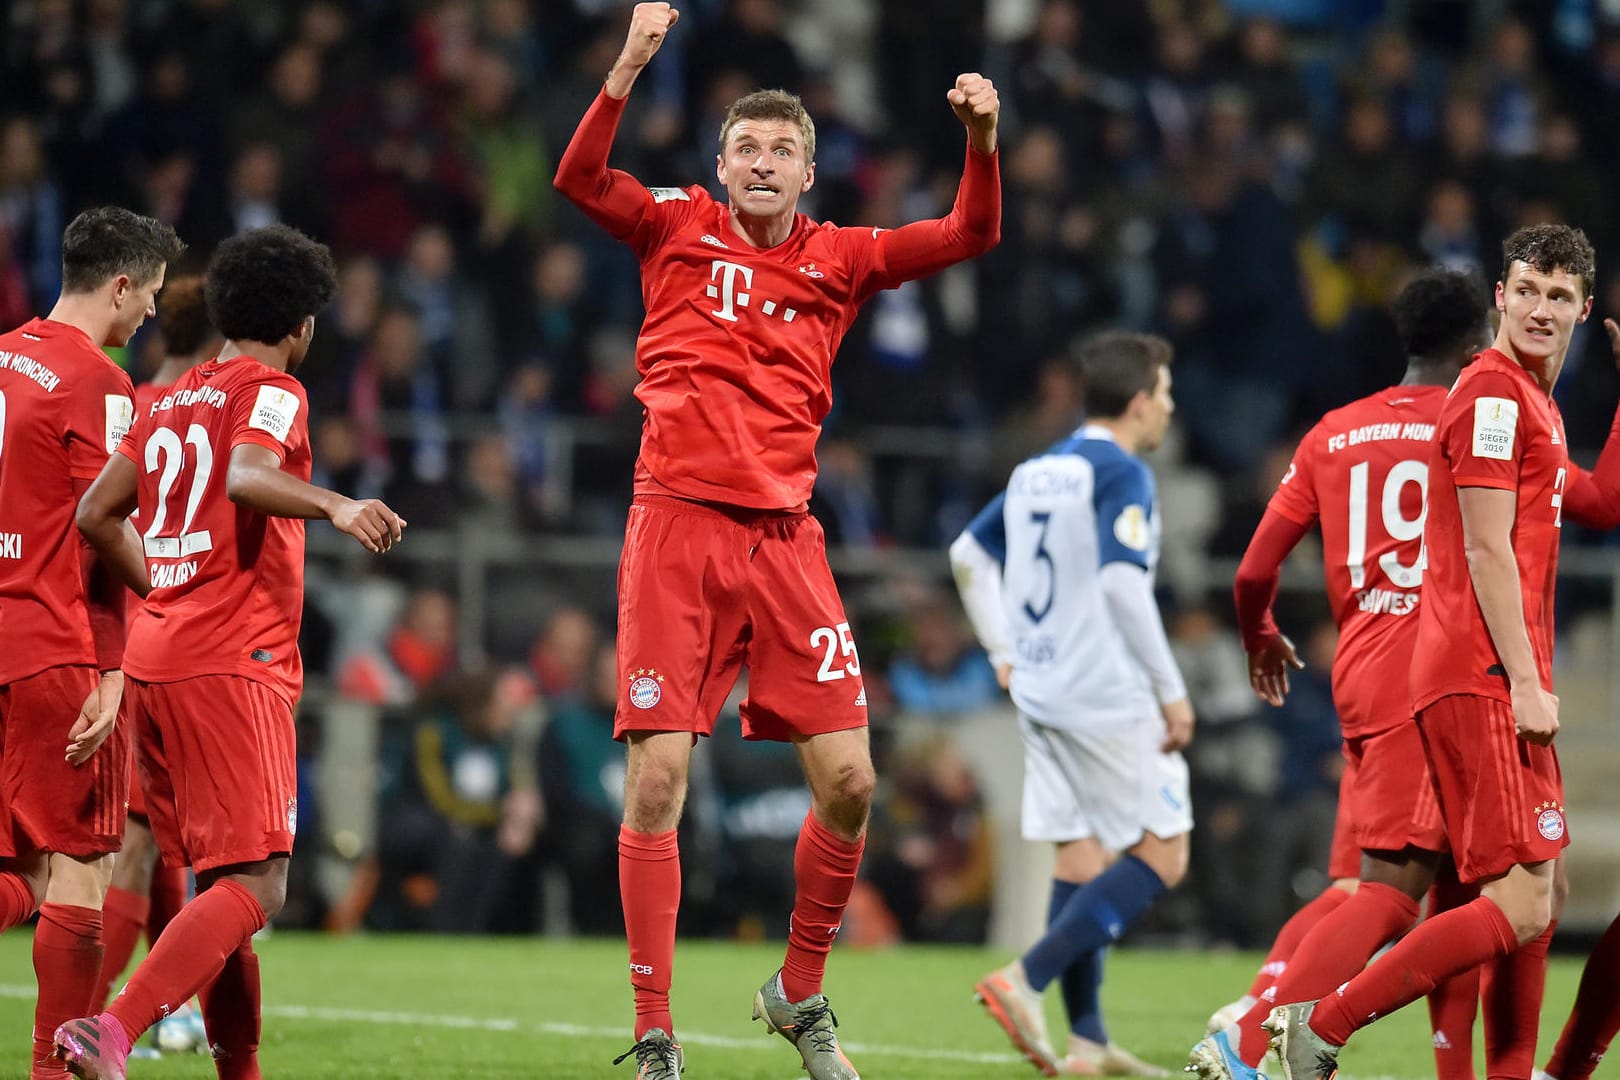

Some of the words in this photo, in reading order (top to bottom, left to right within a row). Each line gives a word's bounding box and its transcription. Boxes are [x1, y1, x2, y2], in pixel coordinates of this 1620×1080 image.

[261, 418, 281, 432] 2019
[1328, 433, 1346, 454] FC
[1348, 423, 1401, 446] BAYERN
[1479, 433, 1509, 444] SIEGER
[1483, 443, 1504, 453] 2019
[143, 424, 213, 558] 22
[1347, 460, 1429, 588] 19
[1023, 510, 1056, 624] 3
[810, 622, 861, 682] 25
[630, 963, 653, 975] FCB
